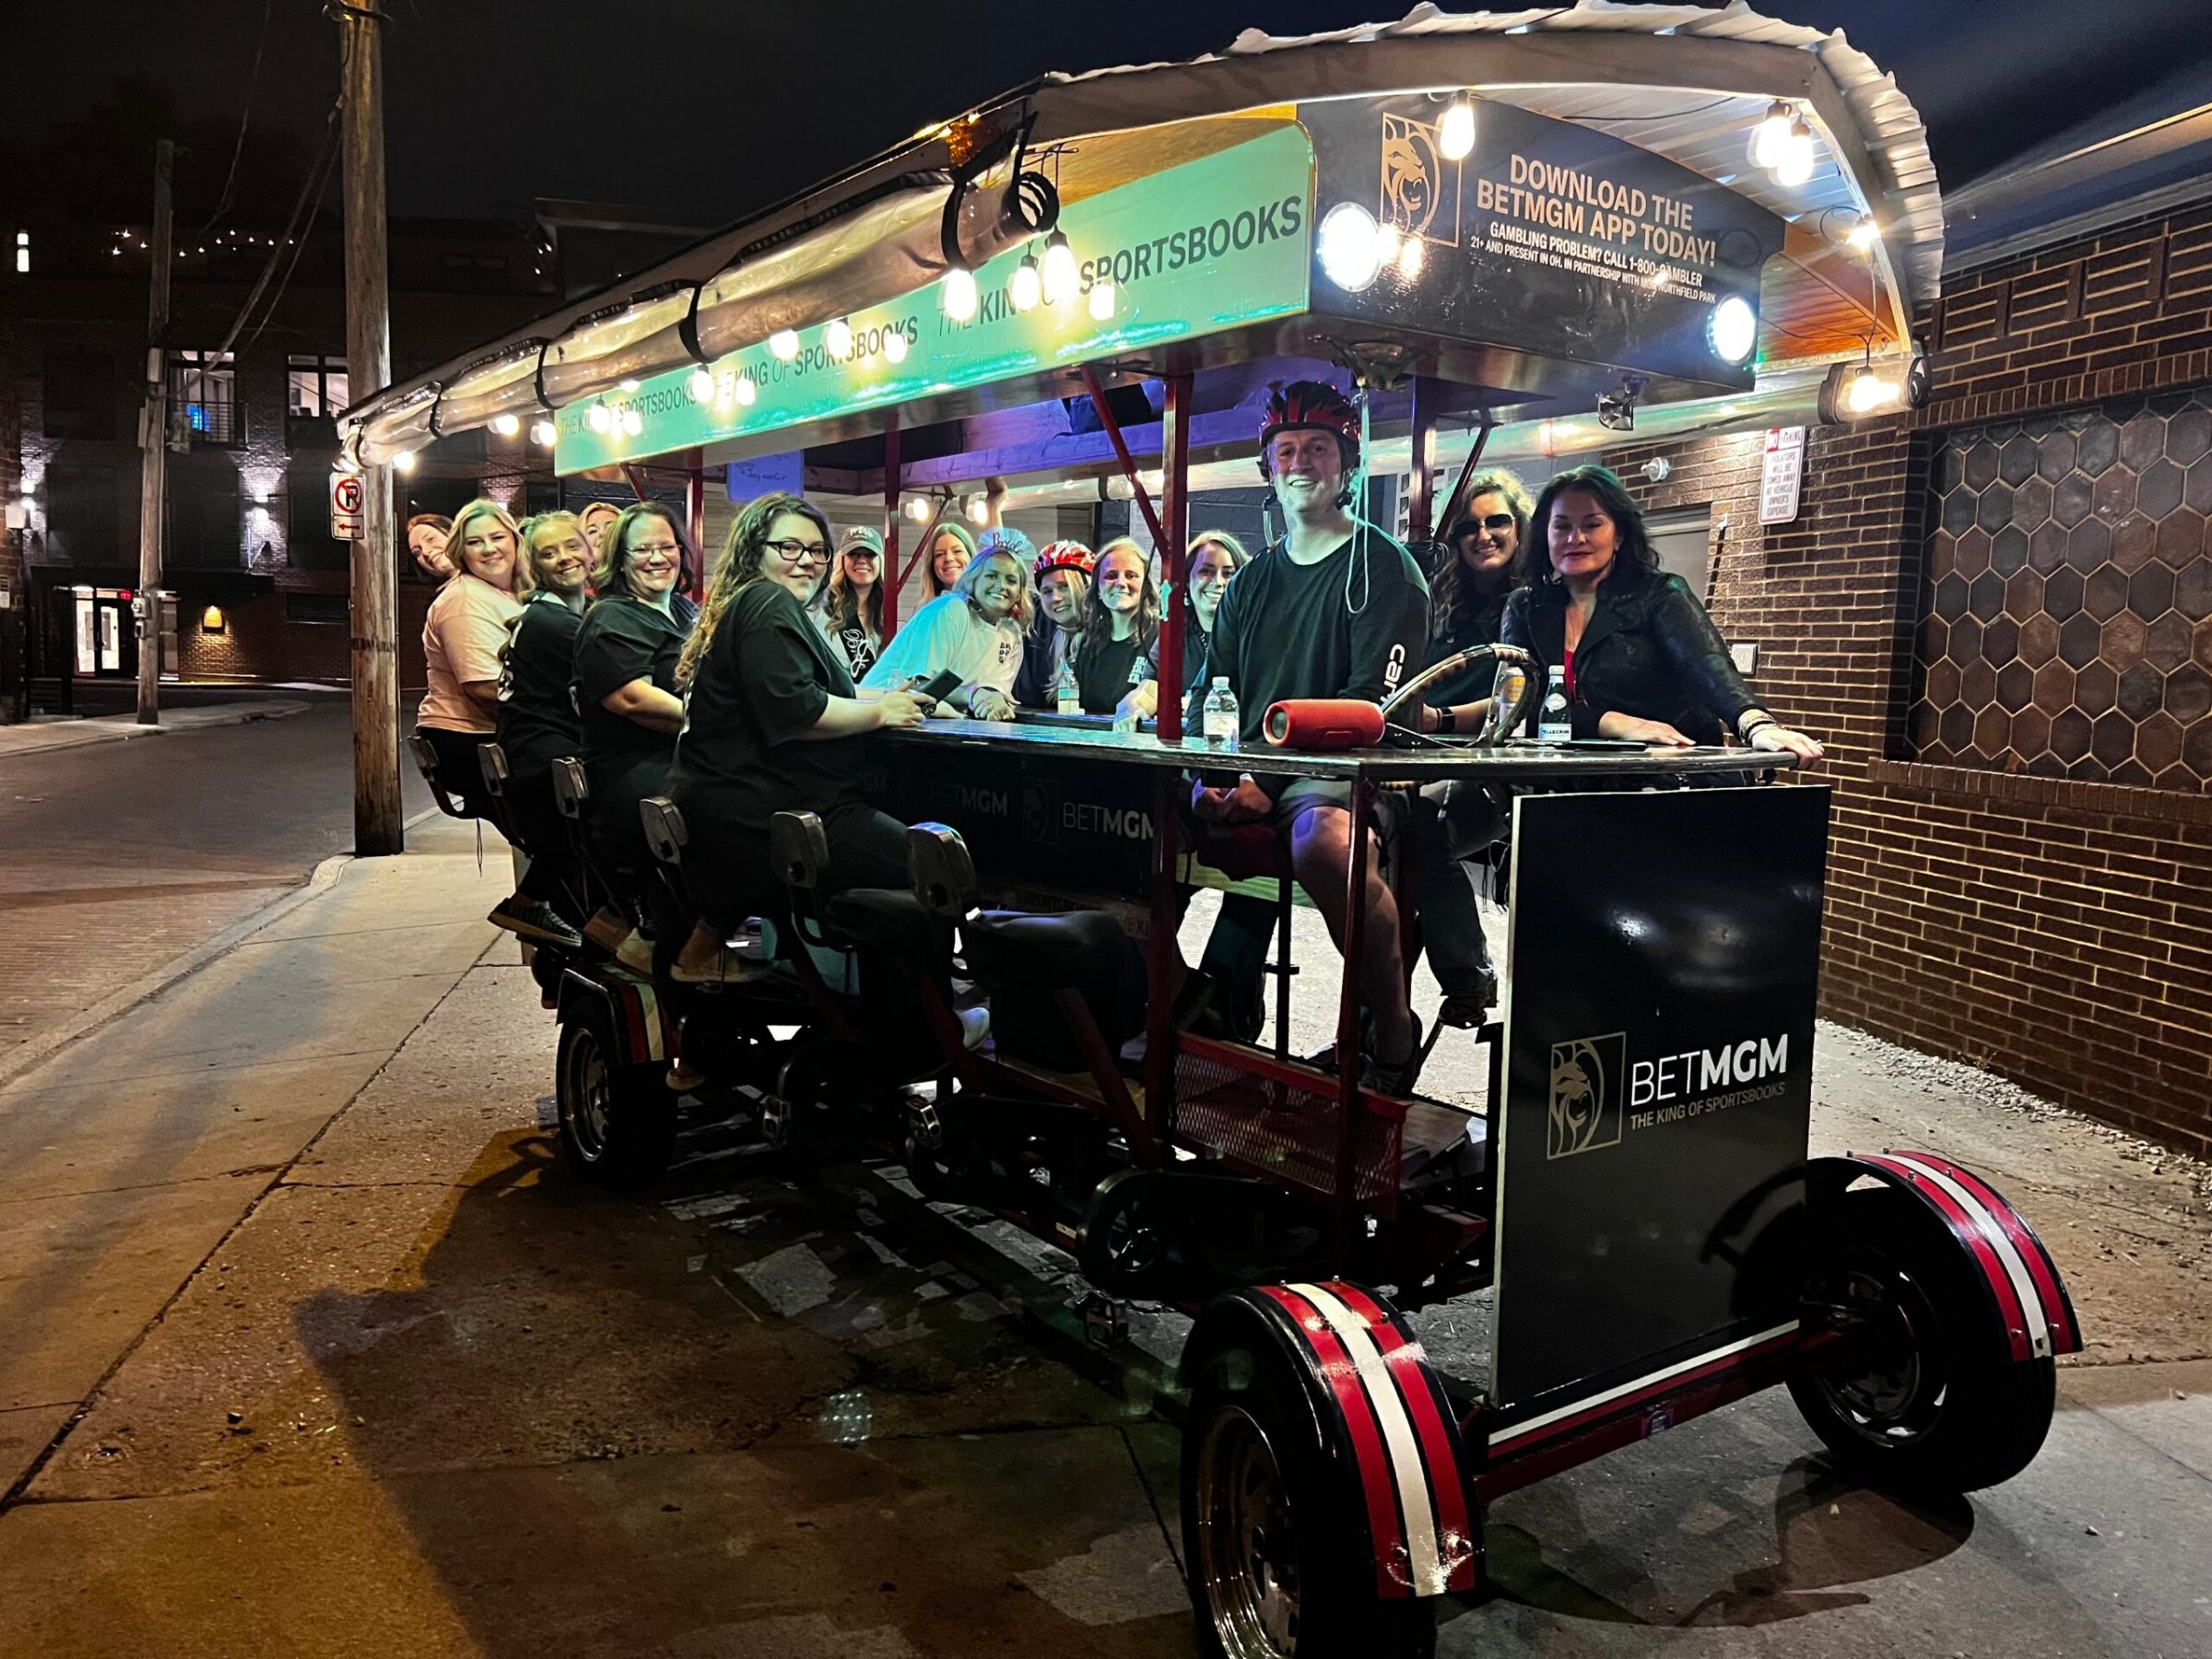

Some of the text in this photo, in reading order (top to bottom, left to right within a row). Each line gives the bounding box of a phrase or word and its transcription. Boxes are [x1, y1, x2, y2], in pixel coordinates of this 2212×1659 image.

[1477, 178, 1716, 267] BETMGM APP TODAY!
[1510, 154, 1693, 230] DOWNLOAD THE
[980, 286, 1031, 324] KIN
[1079, 195, 1301, 295] SPORTSBOOKS
[1471, 236, 1485, 250] 21+
[1485, 240, 1504, 254] AND
[1504, 244, 1539, 262] PRESENT
[1539, 252, 1549, 265] IN
[1563, 258, 1572, 270] IN
[1573, 260, 1622, 282] PARTNERSHIP
[1622, 272, 1640, 286] WITH
[1658, 281, 1699, 300] NORTHFIELD
[1699, 290, 1716, 304] PARK
[1490, 221, 1547, 250] GAMBLING
[1549, 236, 1602, 263] PROBLEM?
[1604, 249, 1628, 269] CALL
[794, 315, 919, 376] SPORSBOOKS
[1631, 1033, 1788, 1106] BETMGM
[1630, 1081, 1785, 1130] THE KING OF SPORTSBOOKS
